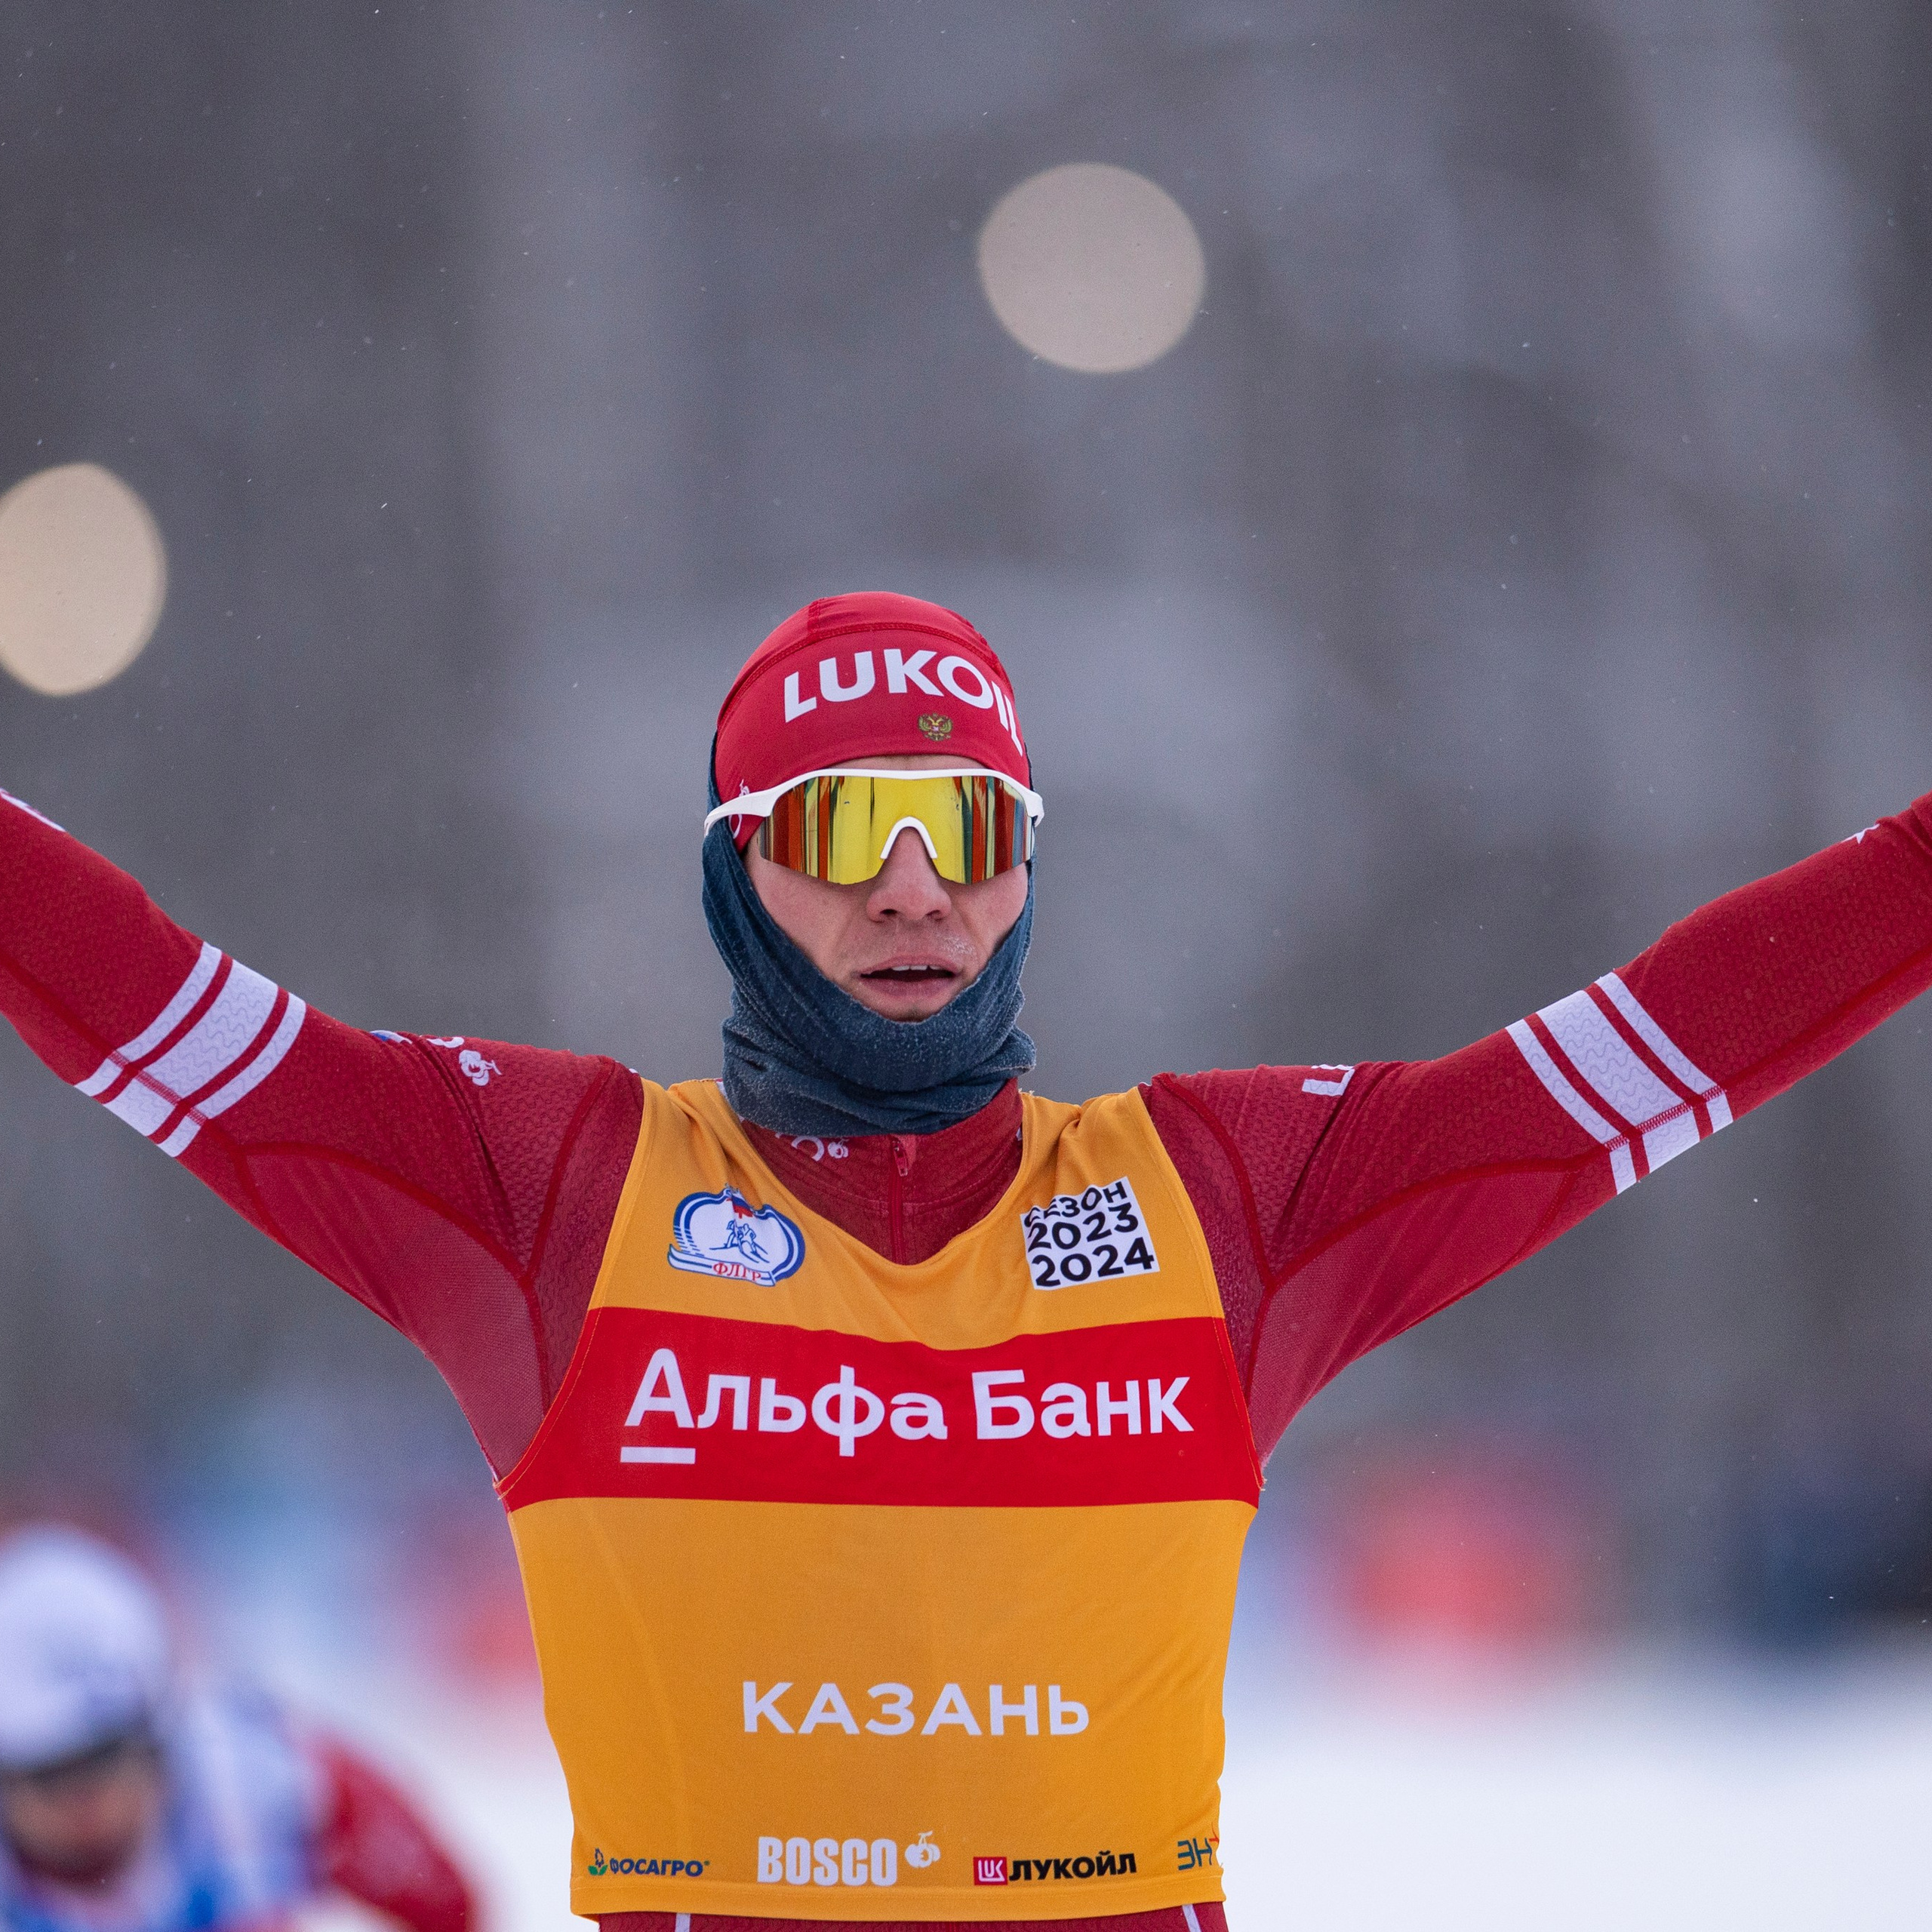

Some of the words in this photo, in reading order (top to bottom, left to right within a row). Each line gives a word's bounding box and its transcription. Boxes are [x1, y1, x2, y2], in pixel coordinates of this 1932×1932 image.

[784, 648, 1023, 757] LUKOIL
[1027, 1201, 1139, 1253] 2023
[1032, 1236, 1155, 1287] 2024
[624, 1348, 948, 1457] Альфа
[971, 1369, 1195, 1440] Банк
[743, 1681, 1090, 1736] КАЗАНЬ
[609, 1857, 703, 1877] ФОСАГРО
[757, 1836, 897, 1887] BOSCO
[1009, 1850, 1137, 1881] ЛУКОЙЛ
